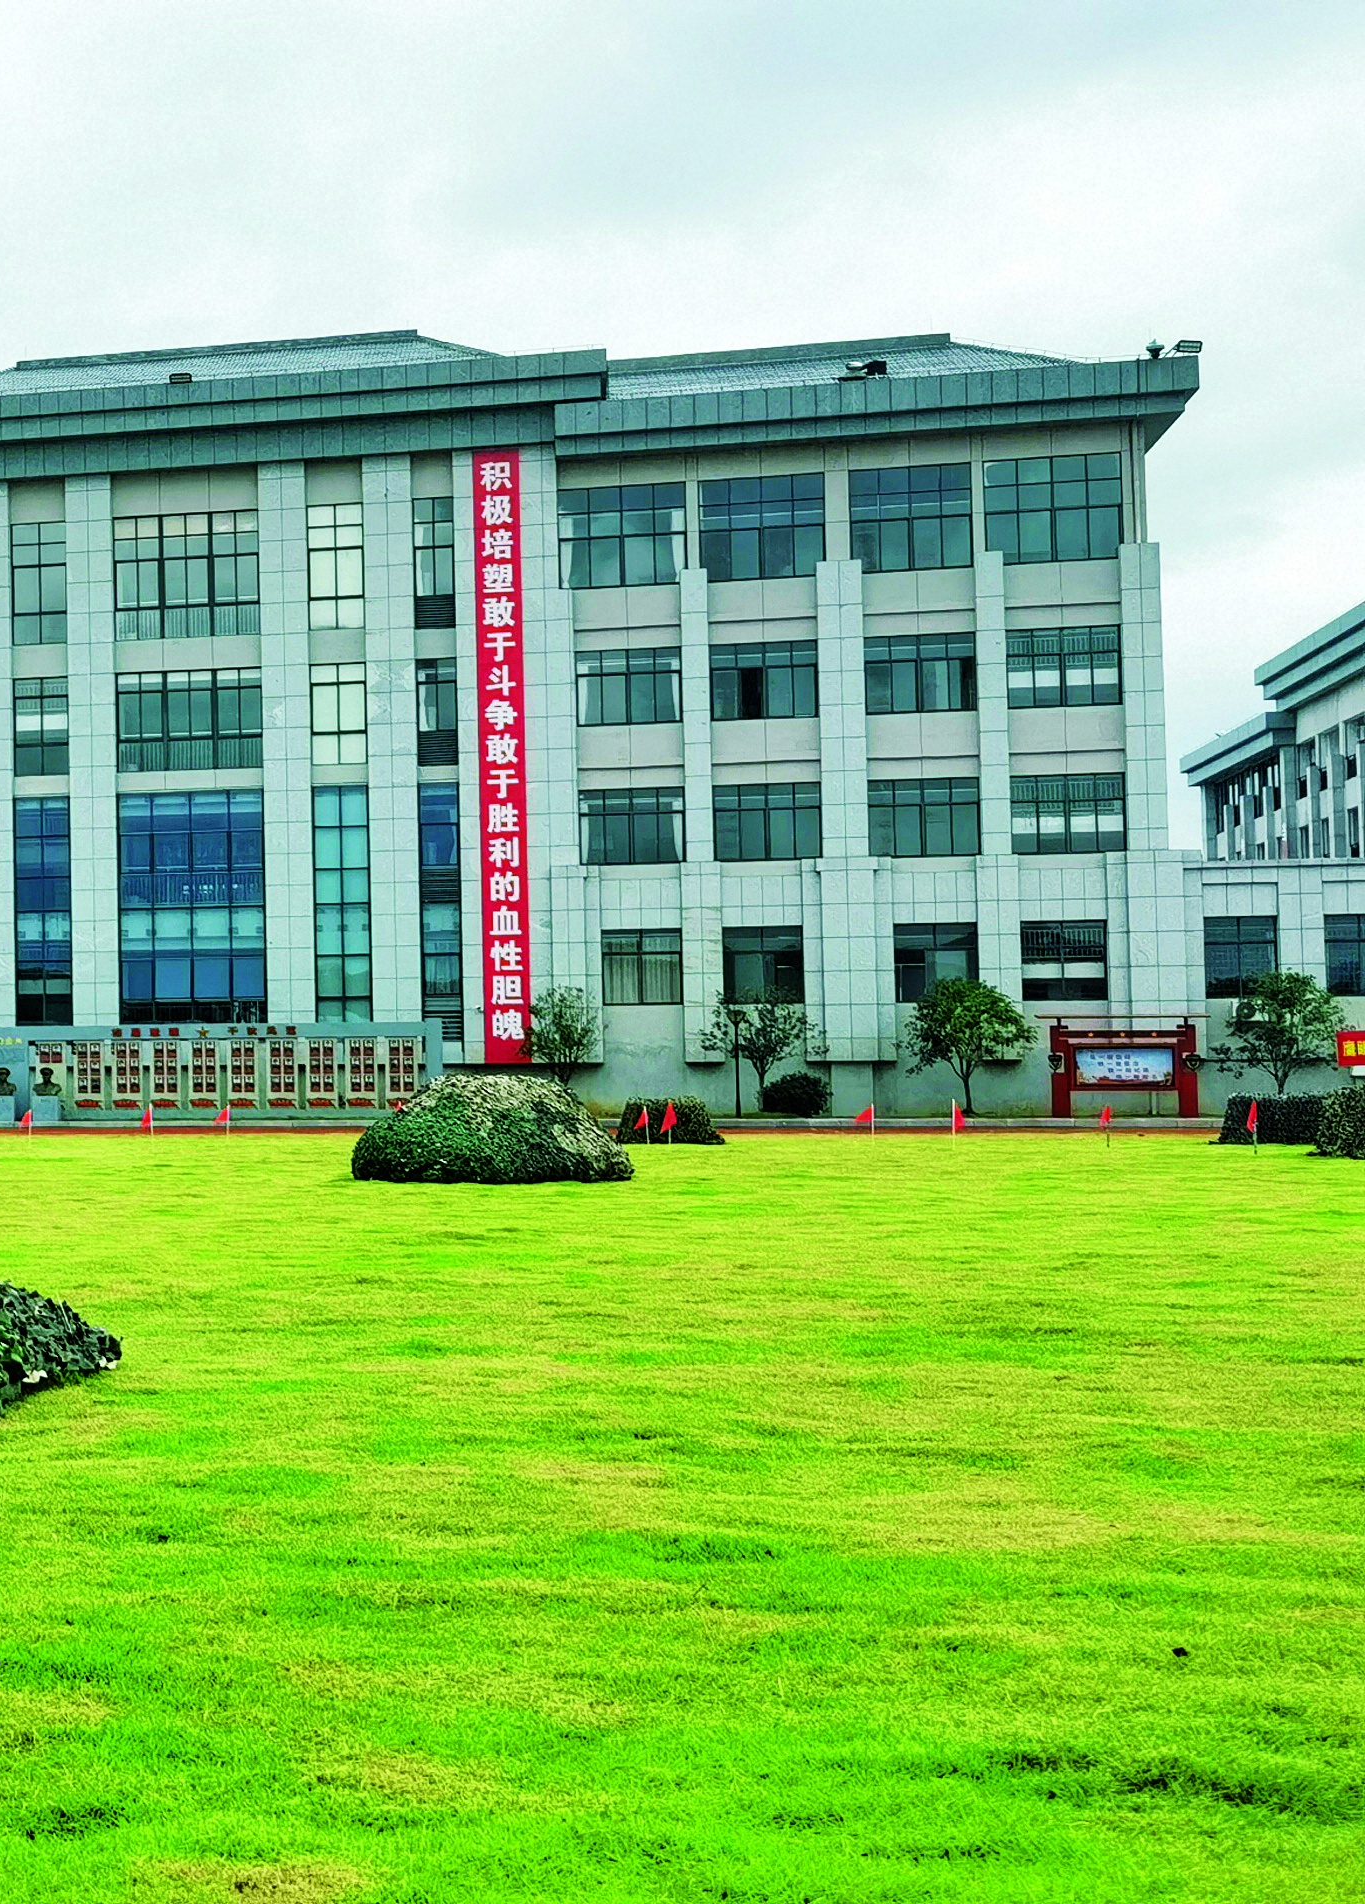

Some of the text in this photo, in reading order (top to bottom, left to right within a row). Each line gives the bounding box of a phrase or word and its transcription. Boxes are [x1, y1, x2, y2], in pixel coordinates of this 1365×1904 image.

[480, 461, 525, 1041] 积极培塑敢于斗争敢于胜利的血性胆魄
